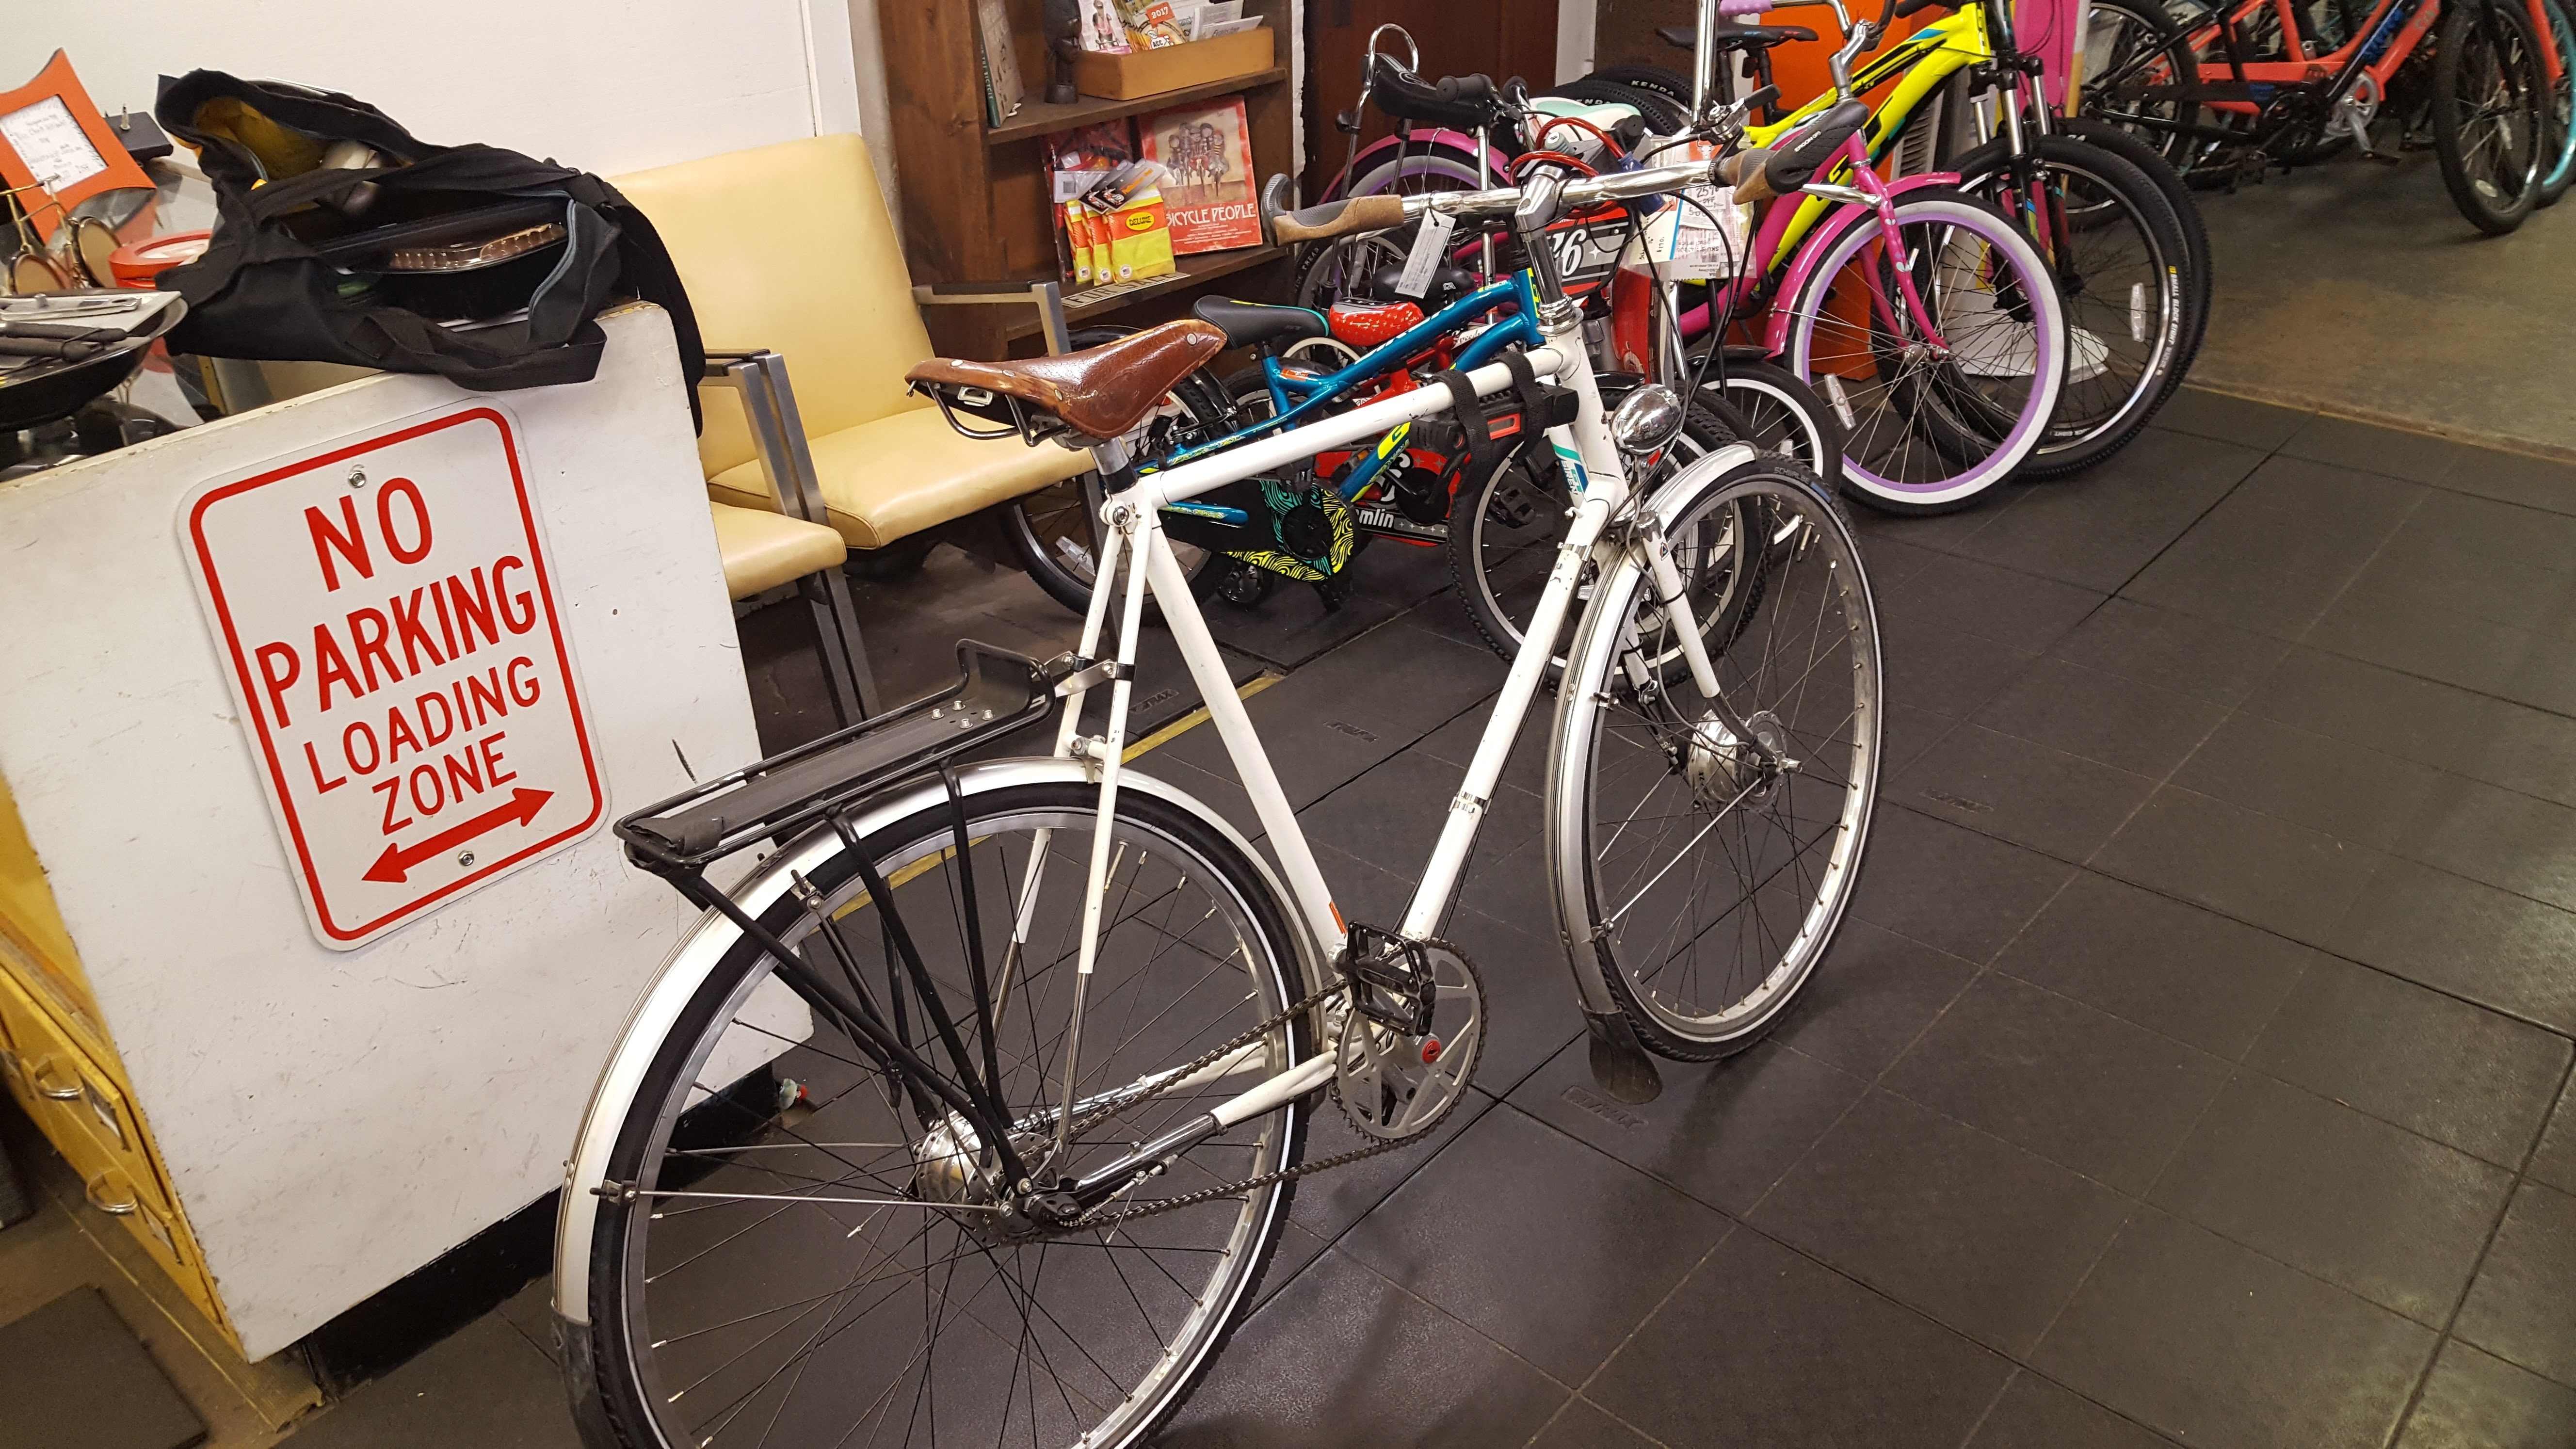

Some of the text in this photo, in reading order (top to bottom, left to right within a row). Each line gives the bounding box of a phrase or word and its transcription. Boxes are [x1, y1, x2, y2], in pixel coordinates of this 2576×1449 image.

[1151, 6, 1169, 19] 2017
[984, 72, 994, 99] BICYCLE
[1631, 80, 1674, 97] KENDA
[1794, 137, 1814, 152] ERGON
[1696, 187, 1720, 198] 25%
[1129, 216, 1152, 226] DELUXE
[1166, 209, 1210, 227] BICYCLE
[1211, 203, 1256, 222] PEOPLE
[1302, 247, 1319, 271] TREAD
[1065, 287, 1118, 304] FOR
[2170, 273, 2179, 297] SMALL
[2172, 298, 2180, 323] BLOCK
[2168, 322, 2178, 345] EIGHT
[1560, 458, 1579, 495] SIREN
[1355, 508, 1394, 528] mlin
[304, 477, 433, 591] NO
[255, 555, 536, 728] PARKING
[304, 655, 542, 794] LOADING
[371, 730, 517, 836] ZONE
